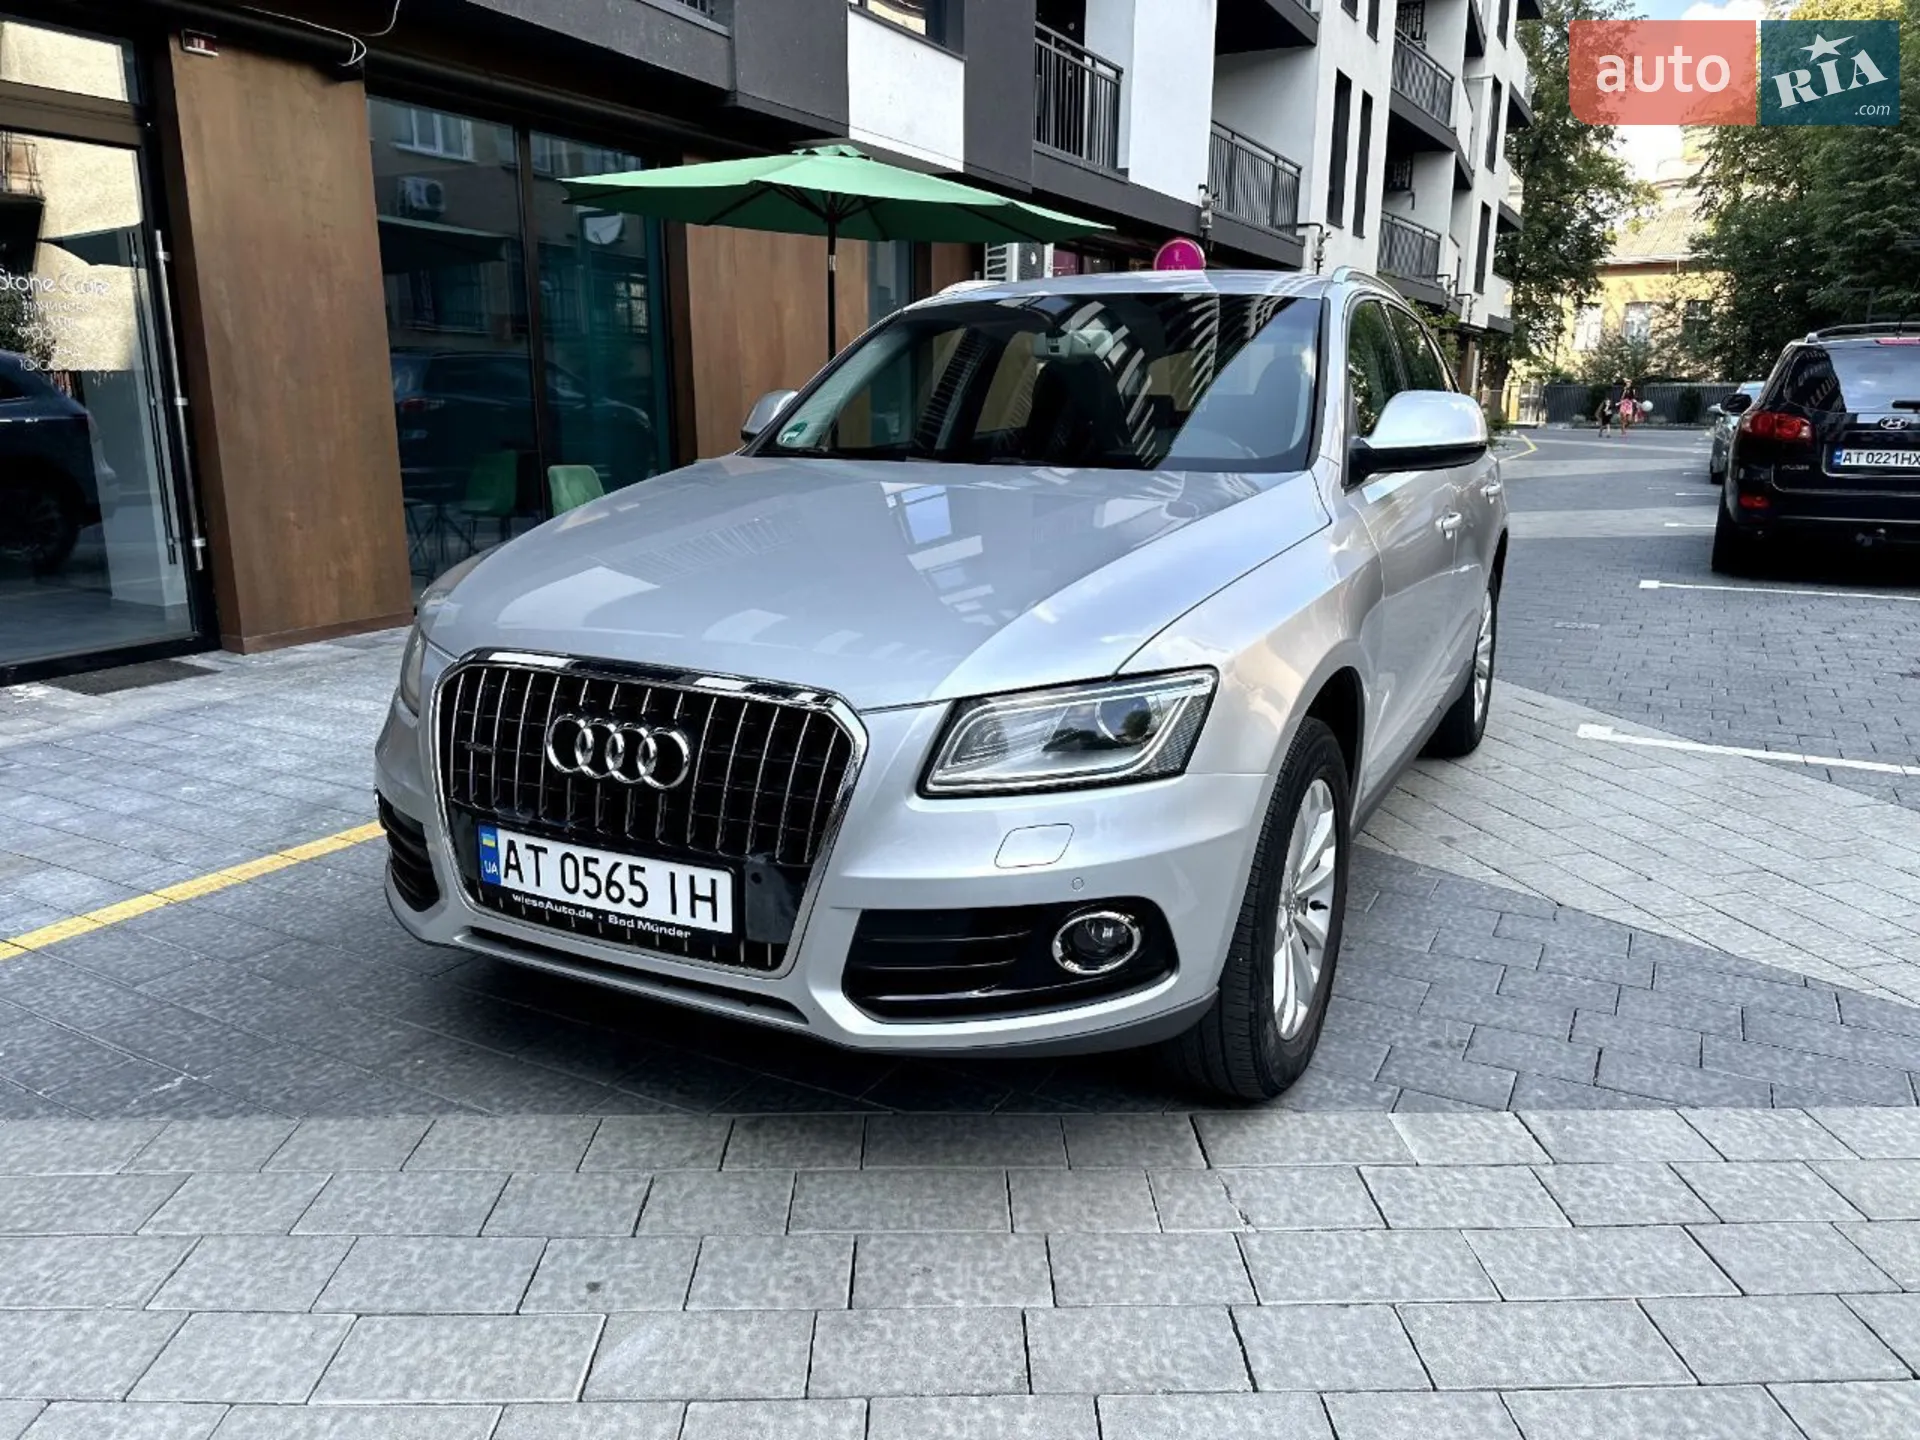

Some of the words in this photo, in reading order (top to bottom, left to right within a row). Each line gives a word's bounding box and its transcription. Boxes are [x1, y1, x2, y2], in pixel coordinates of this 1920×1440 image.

[1842, 452, 1864, 464] AT
[484, 860, 499, 875] UA
[503, 839, 549, 887] AT
[560, 851, 649, 908] 0565
[669, 871, 718, 923] IH
[512, 893, 594, 920] wieseAuto.de
[608, 914, 635, 928] Bad
[637, 920, 691, 939] Münder
